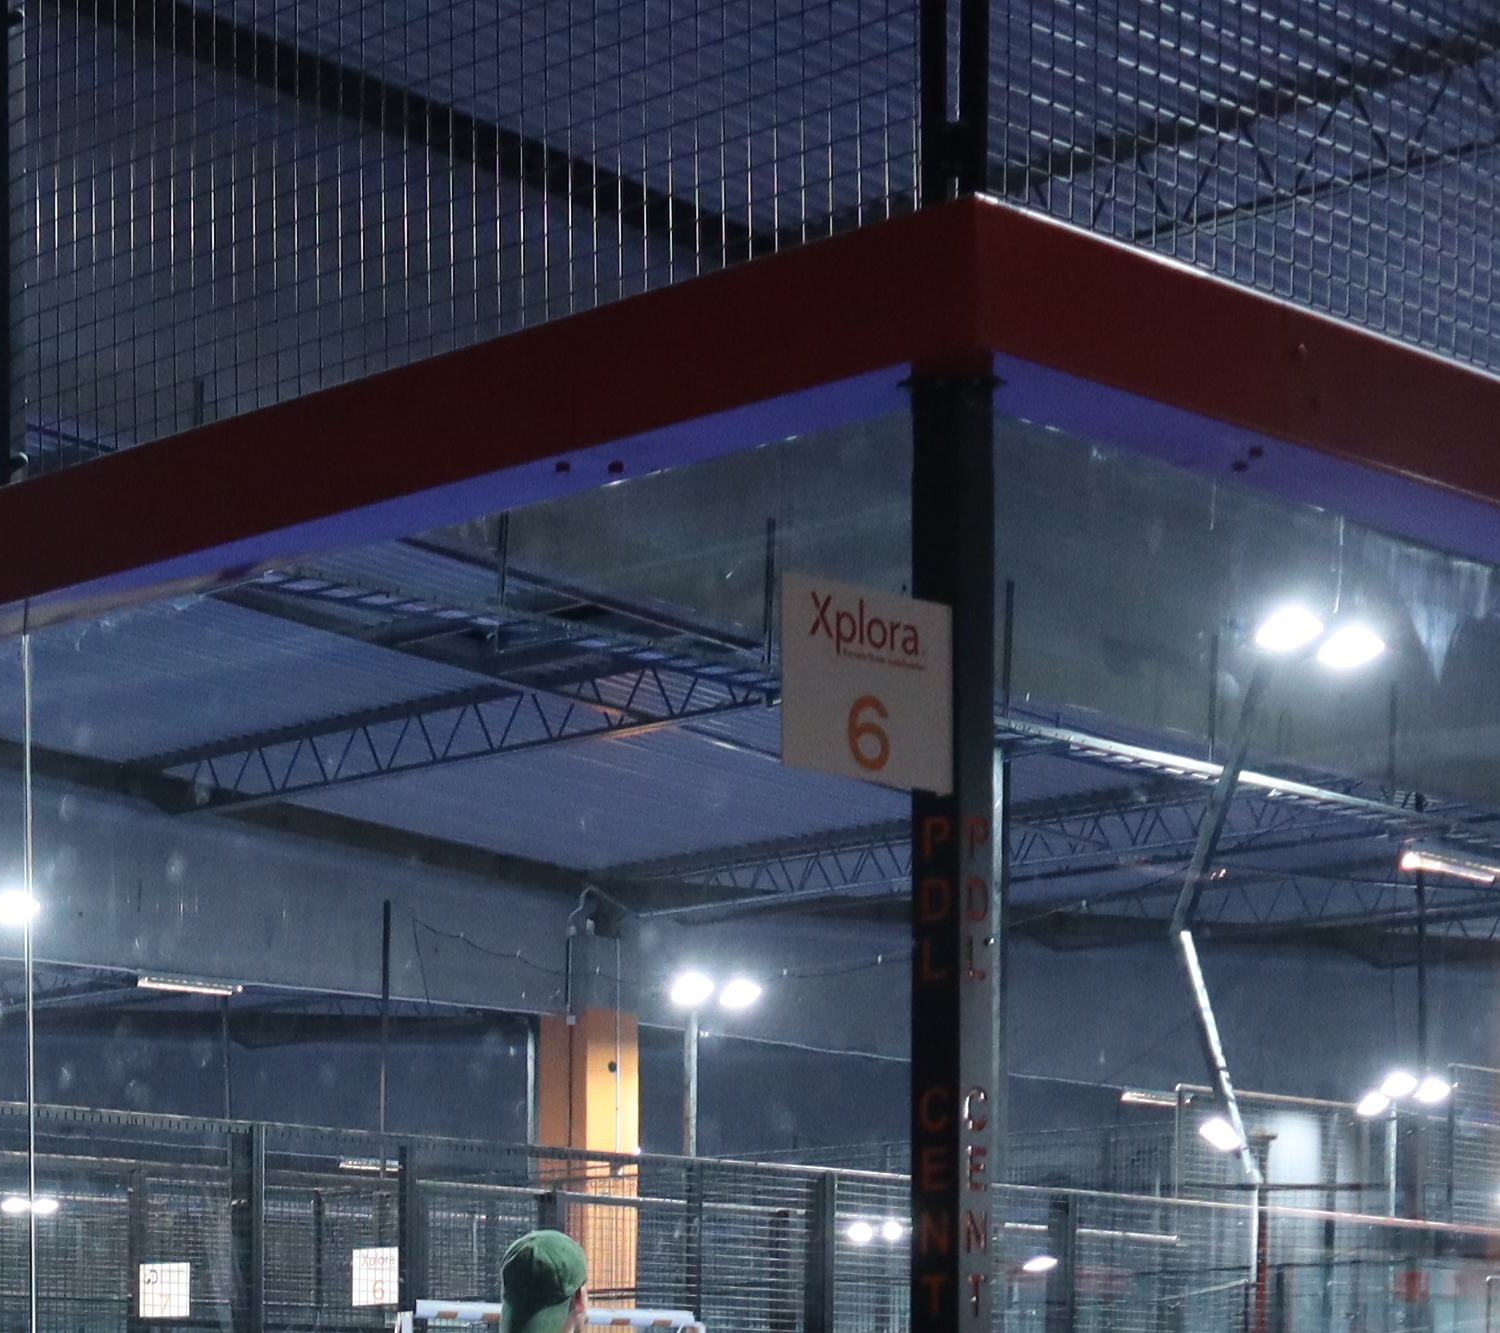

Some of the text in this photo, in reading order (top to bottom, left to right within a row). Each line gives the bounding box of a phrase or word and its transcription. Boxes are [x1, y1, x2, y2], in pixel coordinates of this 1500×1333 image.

[809, 590, 919, 656] Xplora
[847, 694, 891, 772] 6
[920, 815, 952, 981] PDL
[965, 814, 990, 982] PDL
[373, 1280, 385, 1301] 6
